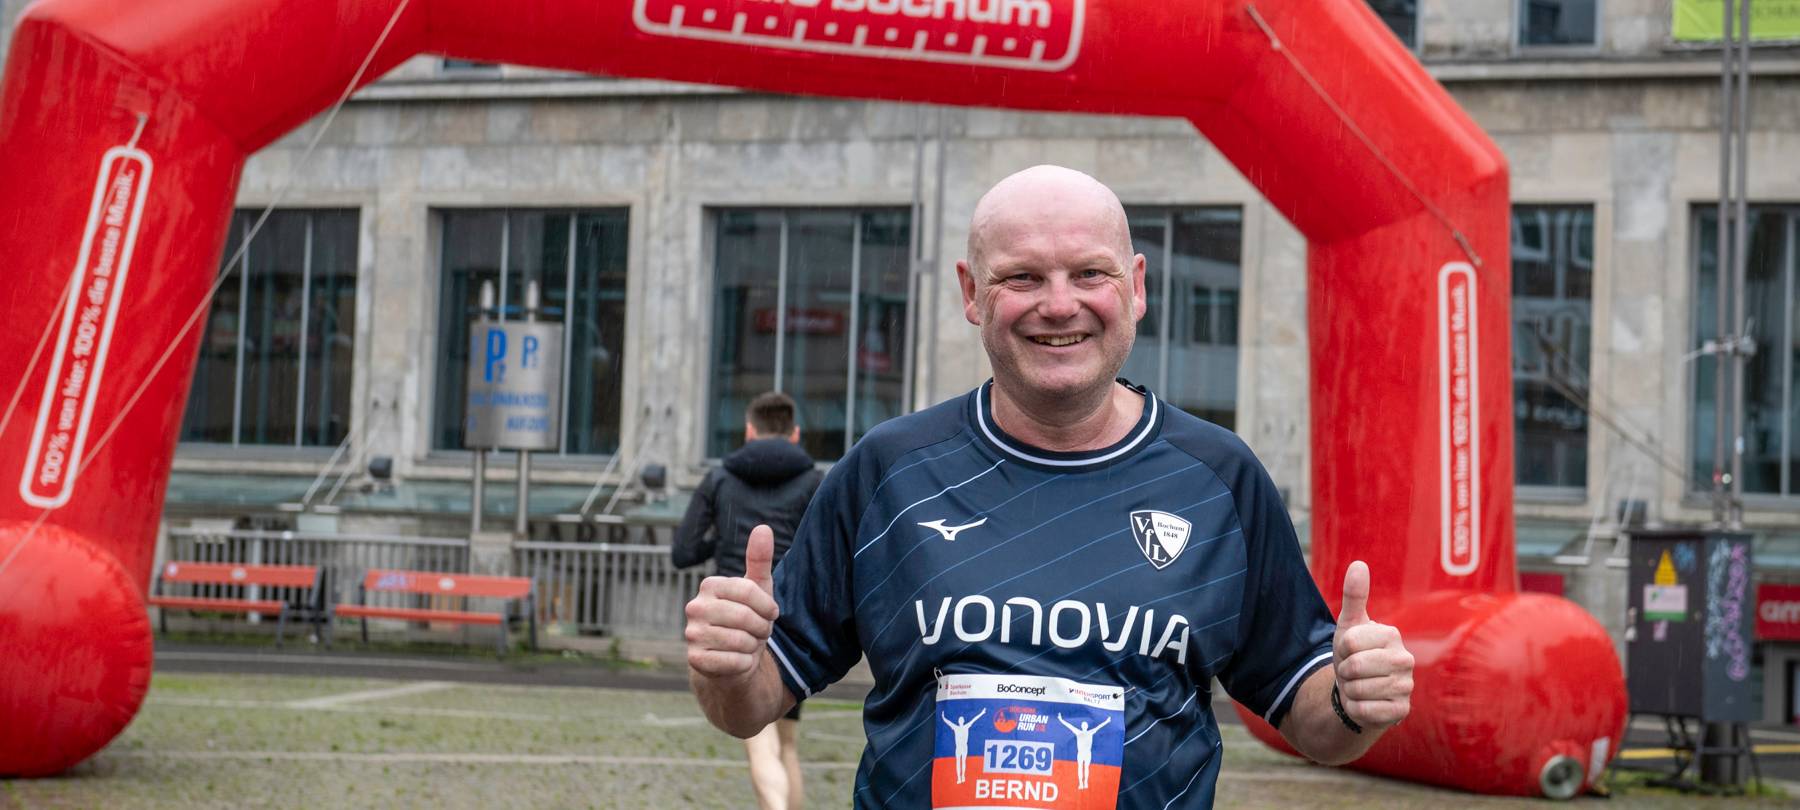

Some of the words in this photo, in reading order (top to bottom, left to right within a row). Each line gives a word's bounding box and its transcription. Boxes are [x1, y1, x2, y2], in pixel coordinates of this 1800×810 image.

[40, 432, 69, 486] 100%
[58, 398, 77, 430] von
[72, 306, 102, 358] 100%
[87, 277, 108, 305] die
[1157, 521, 1185, 532] Bochum
[1163, 530, 1178, 539] 1848
[1454, 511, 1469, 557] 100%
[997, 683, 1046, 696] BoConcept
[1019, 713, 1049, 724] URBAN
[1017, 722, 1035, 731] RUN
[987, 744, 1052, 771] 1269
[975, 779, 1059, 802] BERND
